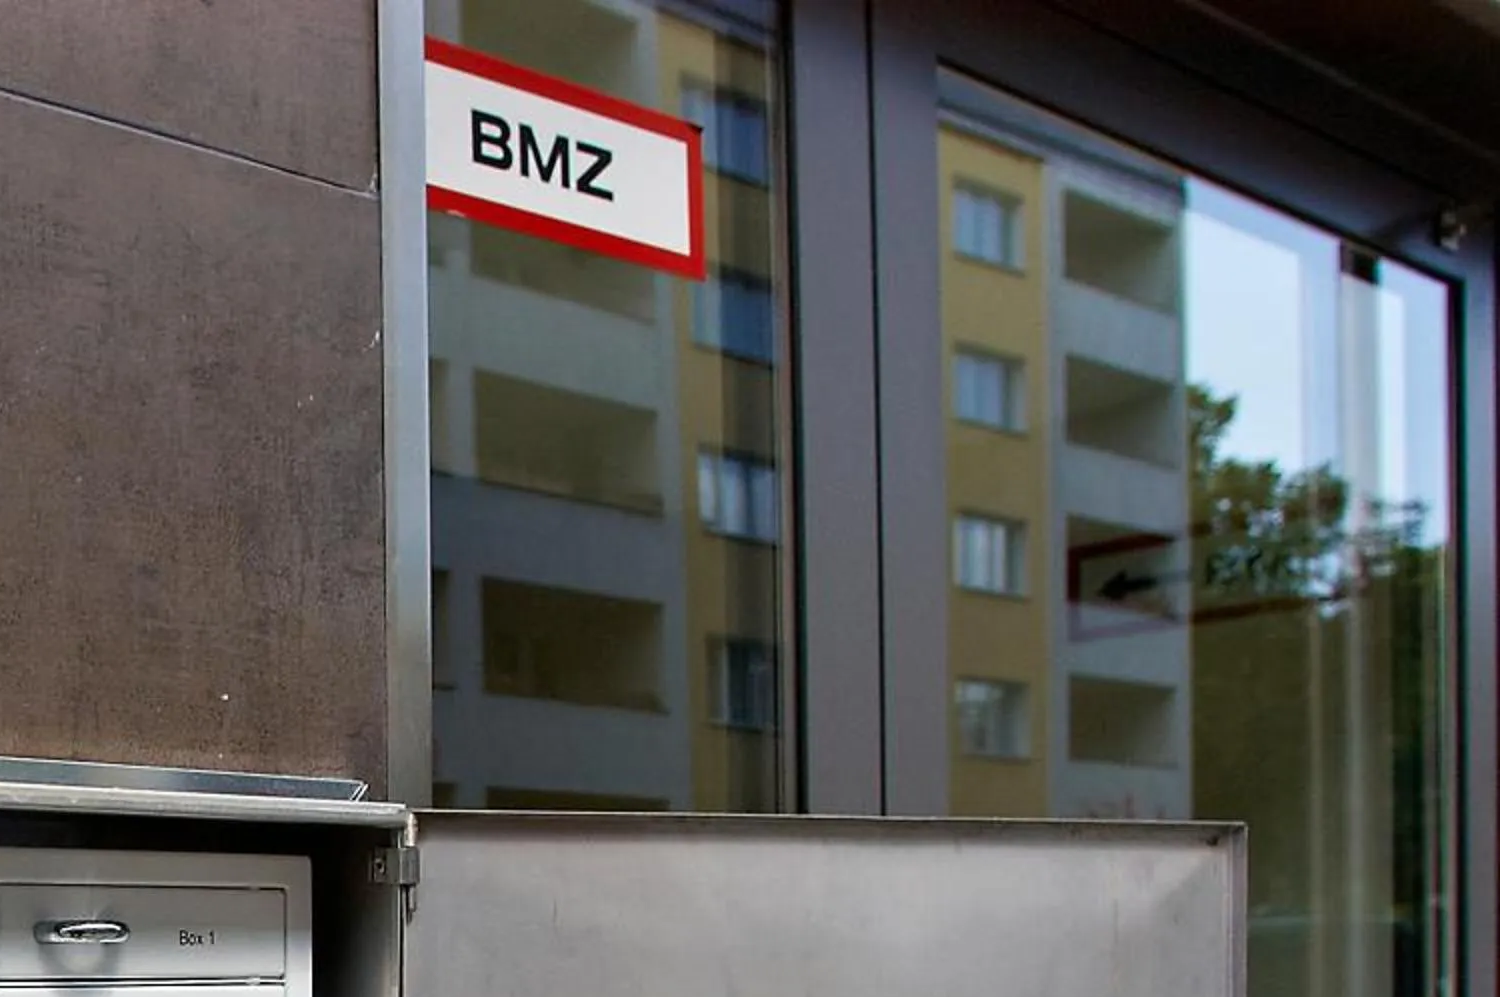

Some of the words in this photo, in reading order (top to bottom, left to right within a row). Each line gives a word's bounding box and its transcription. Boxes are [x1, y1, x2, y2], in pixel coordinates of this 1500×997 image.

[471, 109, 614, 202] BMZ
[179, 929, 204, 946] Box
[208, 931, 215, 945] 1
